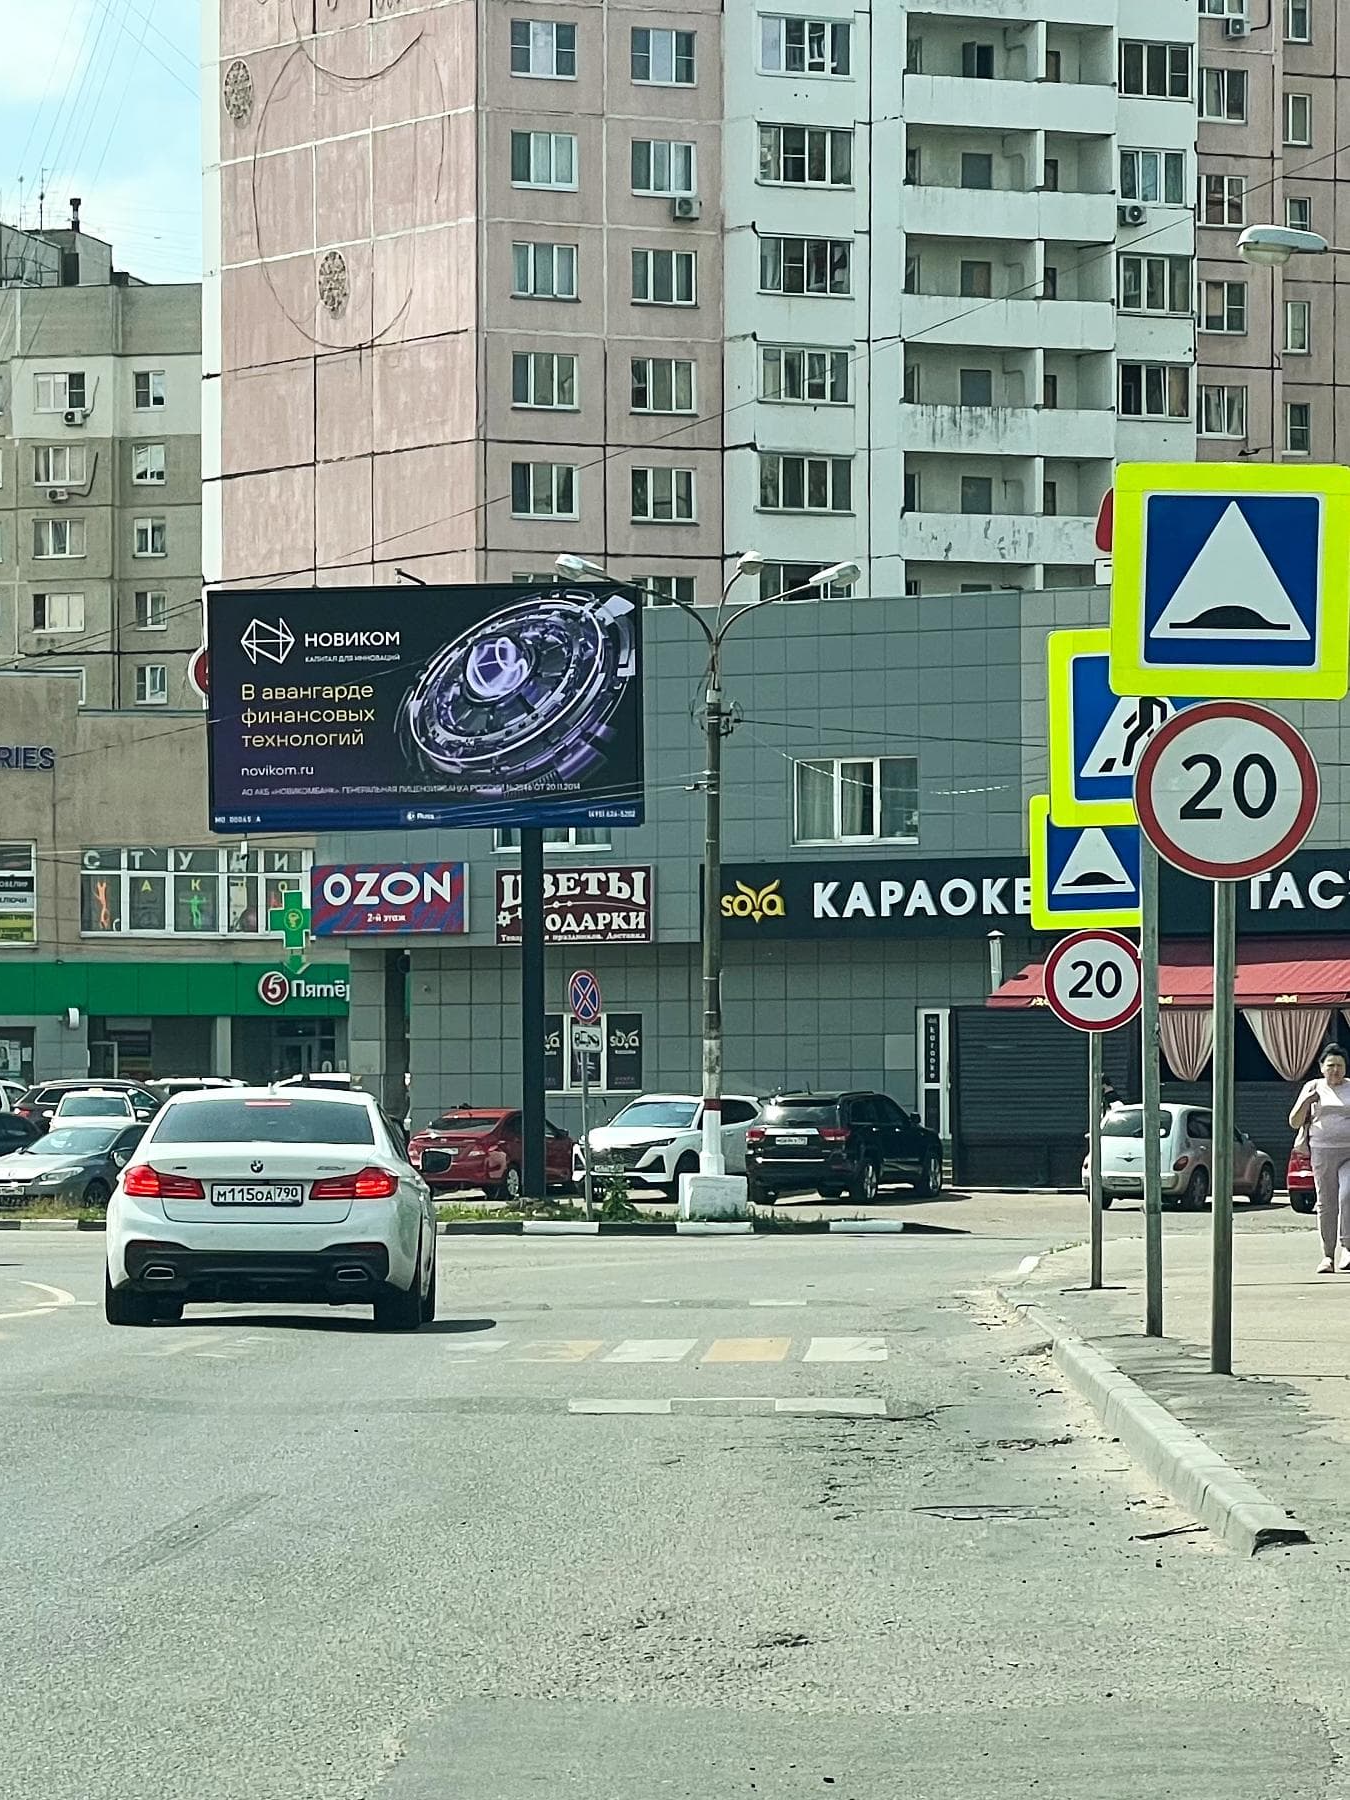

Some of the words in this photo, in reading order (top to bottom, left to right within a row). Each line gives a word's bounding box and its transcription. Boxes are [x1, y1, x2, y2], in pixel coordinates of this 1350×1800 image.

[304, 631, 400, 648] НОВИКОМ
[241, 683, 255, 700] В
[261, 685, 374, 703] авангарде
[241, 707, 375, 728] финансовых
[241, 728, 364, 748] технологий
[241, 765, 314, 777] novikom.ru
[1179, 753, 1278, 820] 20
[323, 871, 451, 906] OZON
[813, 878, 1032, 918] КАРАОКЕ
[543, 911, 646, 933] ОДАРКИ
[1068, 960, 1123, 999] 20
[216, 1187, 273, 1201] М115ОА
[276, 1187, 299, 1198] 790
